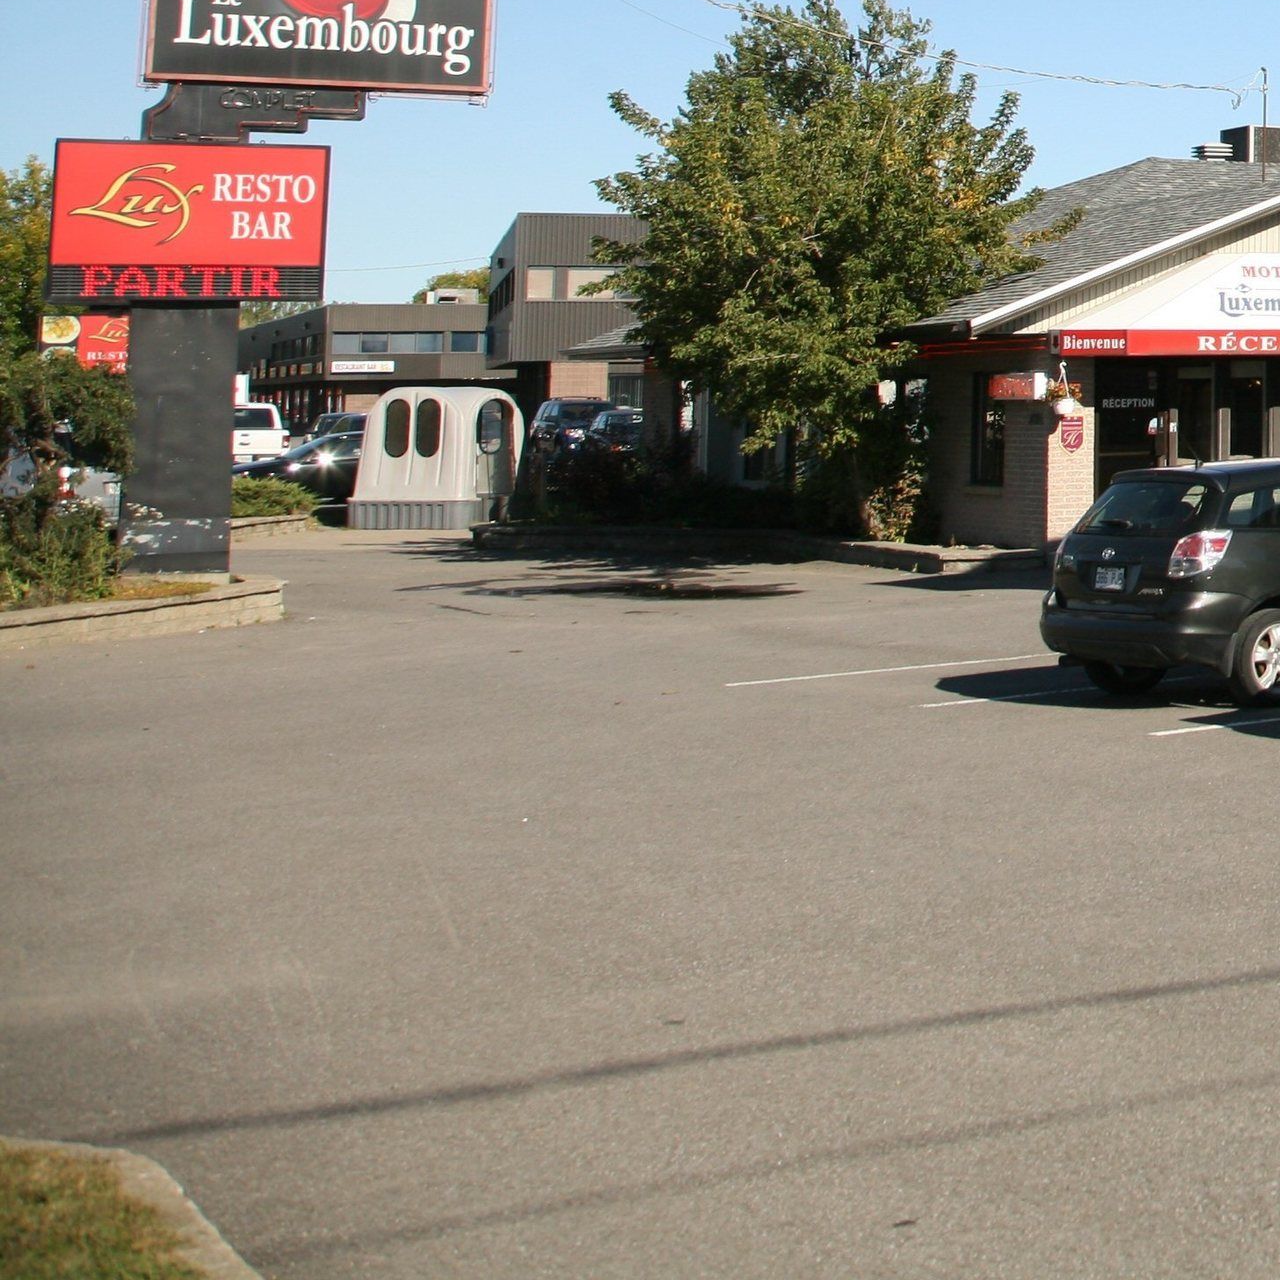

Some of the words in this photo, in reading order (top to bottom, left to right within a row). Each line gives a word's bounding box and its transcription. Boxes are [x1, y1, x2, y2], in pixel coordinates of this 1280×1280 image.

[211, 172, 316, 204] RESTO
[69, 162, 204, 247] Lux
[230, 210, 292, 240] BAR
[80, 265, 281, 298] PARTIR
[1063, 335, 1126, 351] Bienvenue
